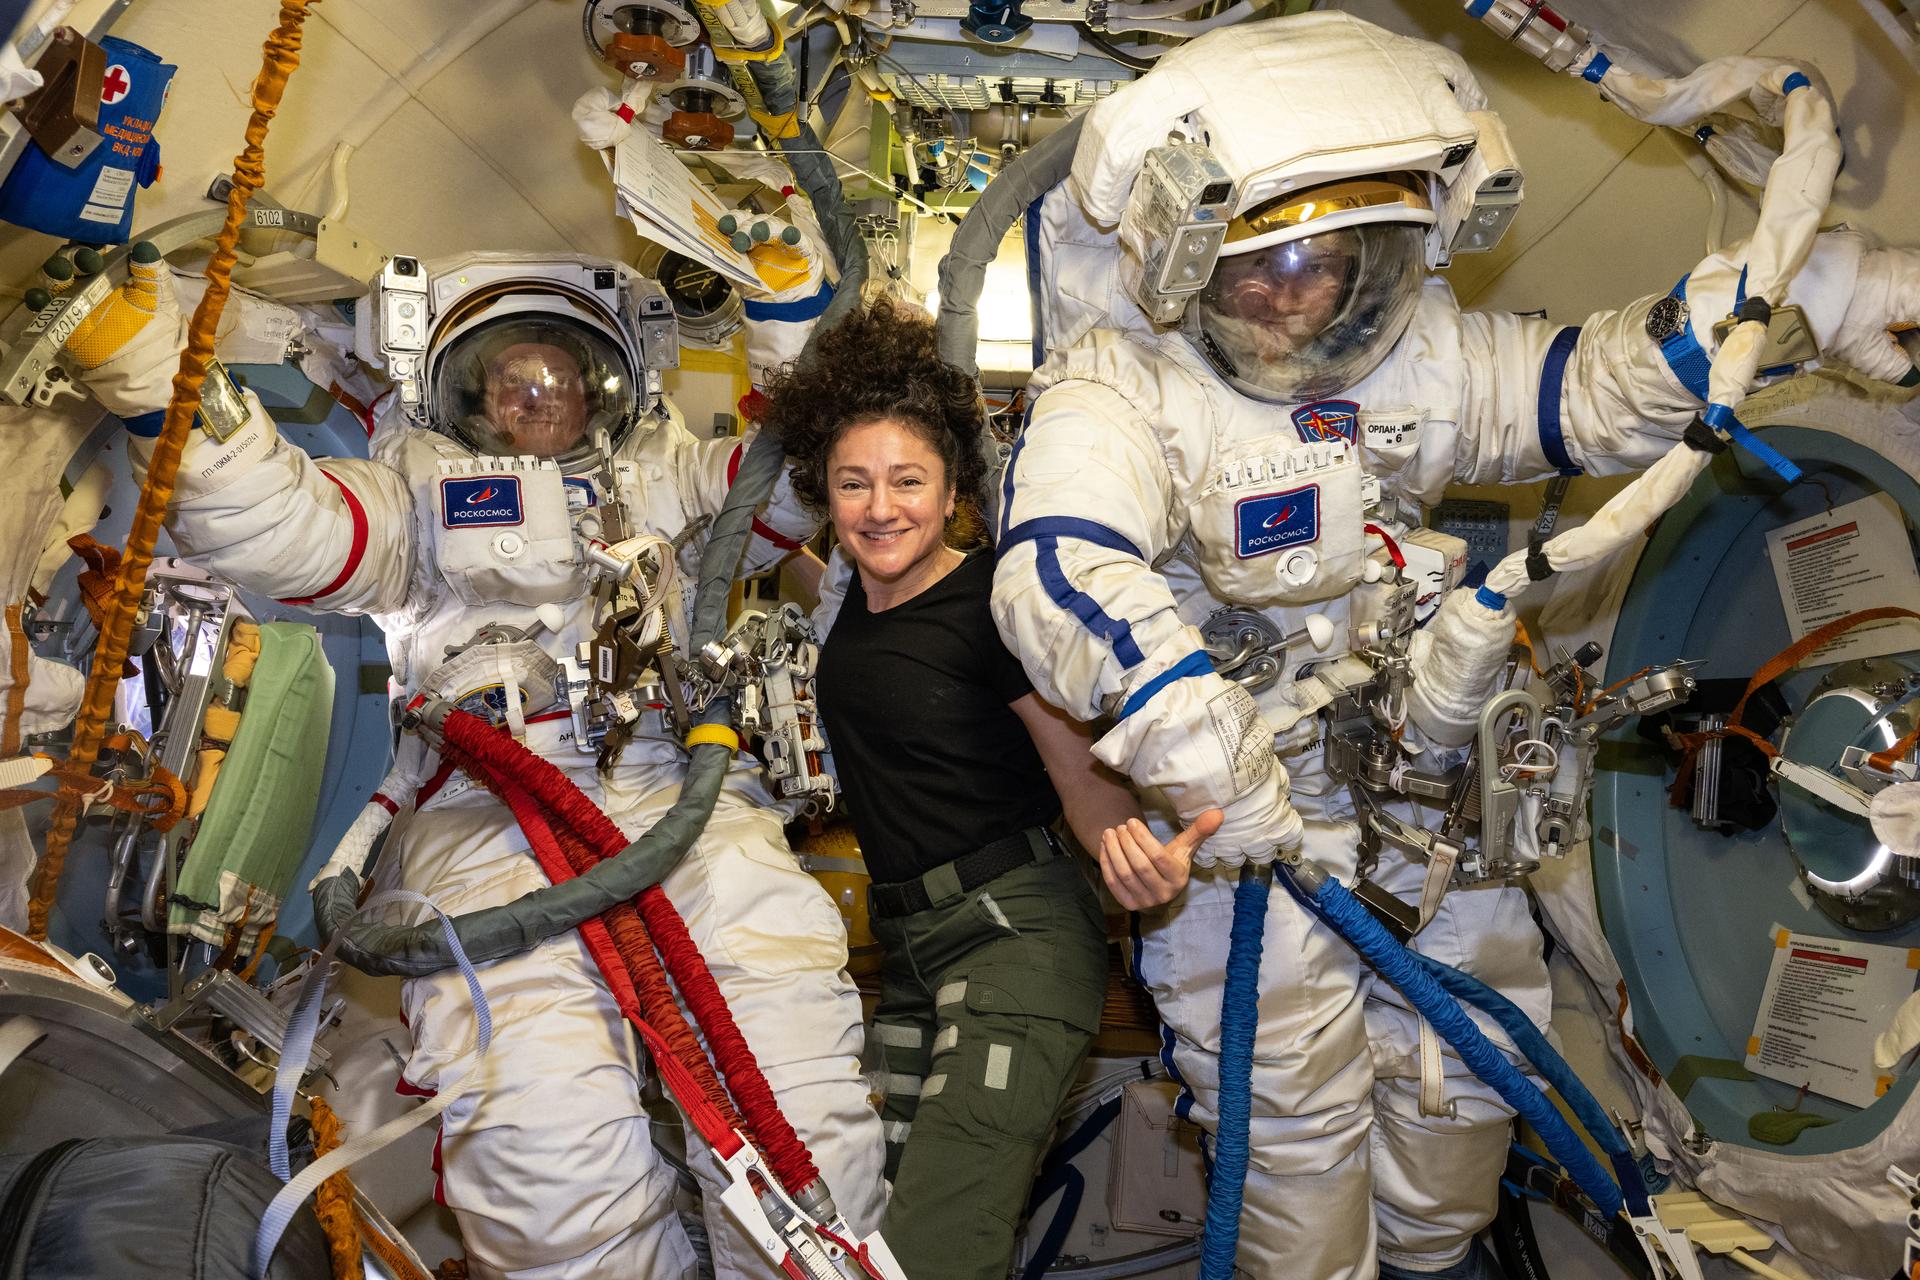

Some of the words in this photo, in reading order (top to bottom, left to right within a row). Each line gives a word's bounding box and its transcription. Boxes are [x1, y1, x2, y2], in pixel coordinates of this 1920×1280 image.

[256, 210, 281, 225] 6102
[30, 299, 66, 329] 6102
[52, 305, 82, 343] 6102
[1368, 424, 1396, 434] ОРЛАН
[1401, 422, 1417, 433] МКС
[1395, 433, 1403, 444] 6
[454, 508, 513, 518] РОСКОСМОС
[1248, 526, 1309, 547] РОСКОСМОС
